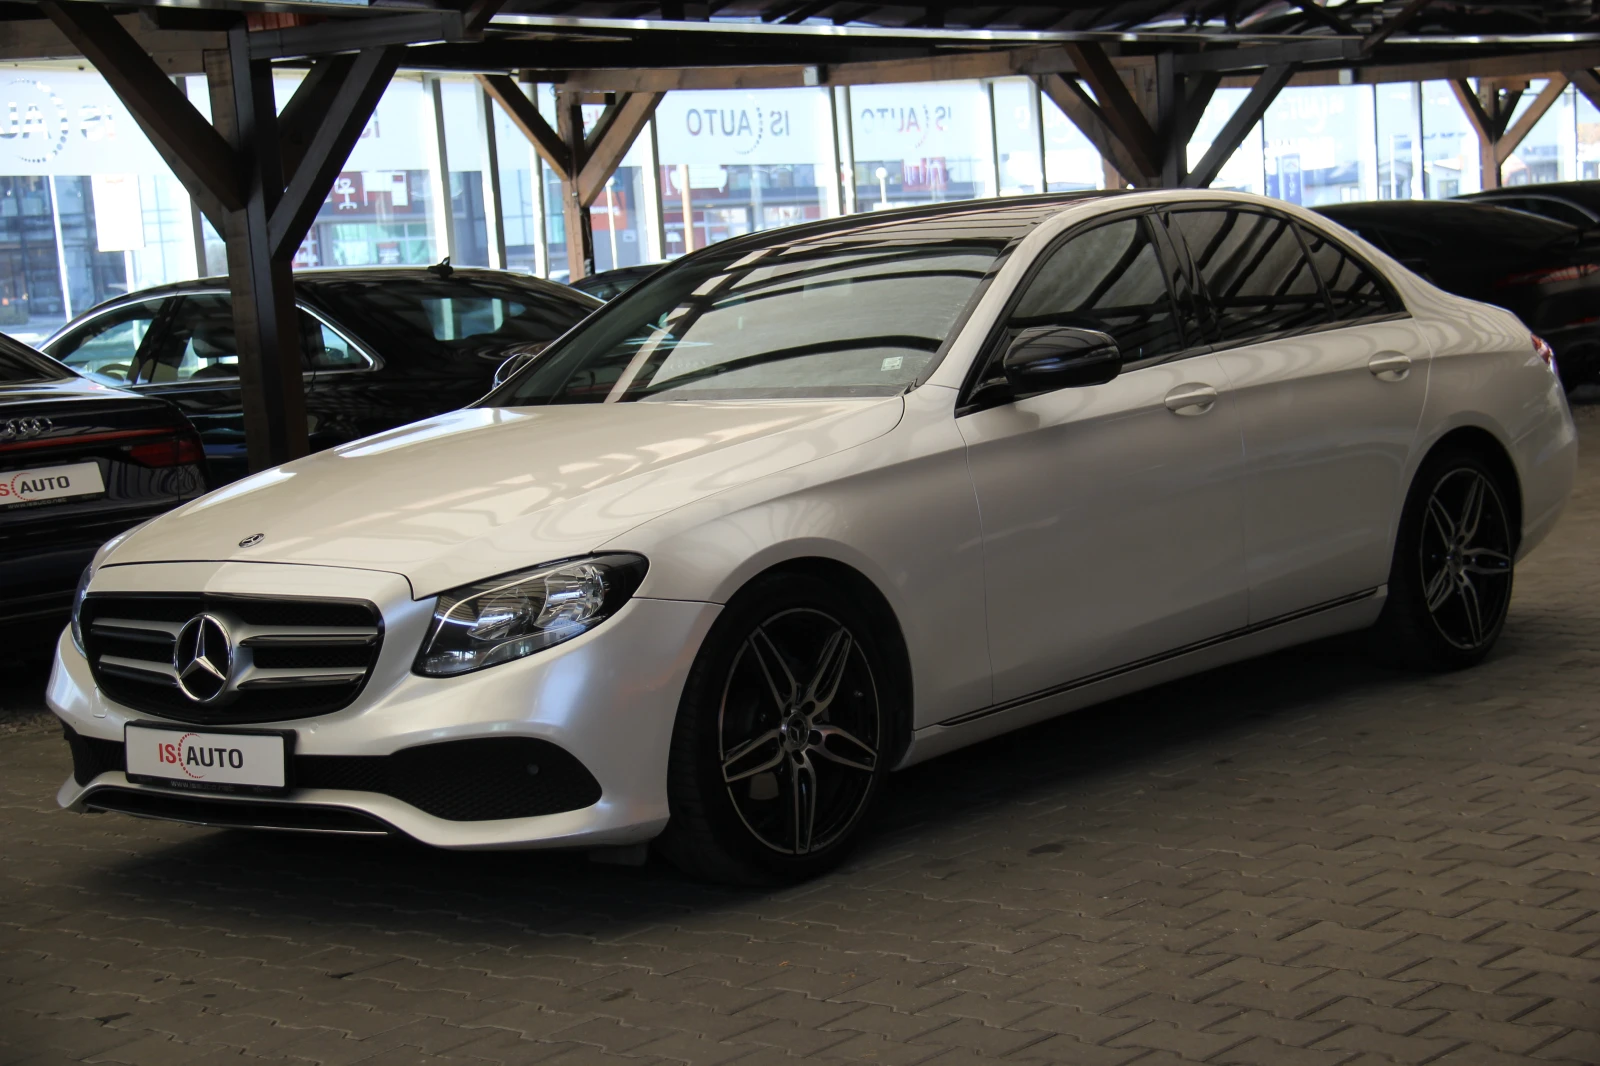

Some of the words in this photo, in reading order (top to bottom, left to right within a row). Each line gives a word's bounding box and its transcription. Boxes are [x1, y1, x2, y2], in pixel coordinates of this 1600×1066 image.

[20, 476, 70, 494] AUTO
[158, 743, 177, 763] IS
[186, 746, 244, 768] AUTO
